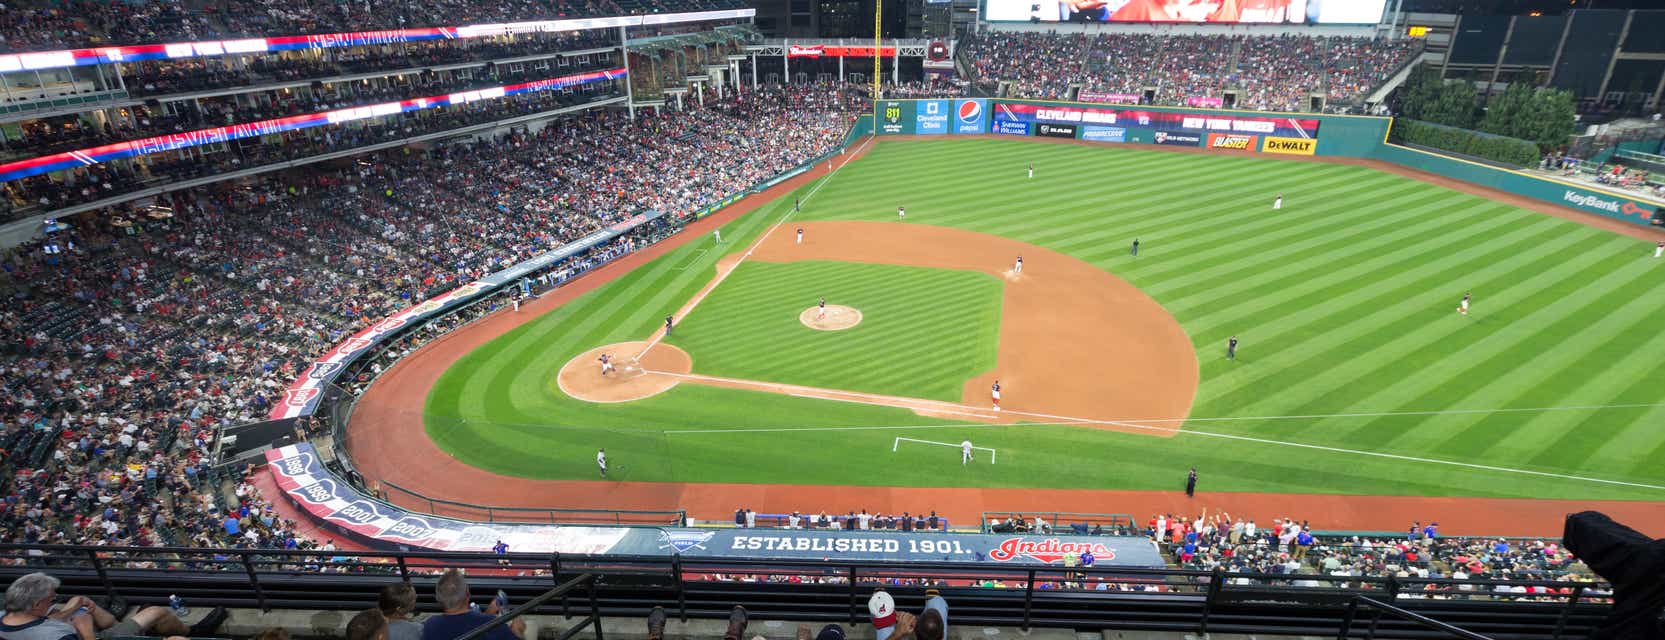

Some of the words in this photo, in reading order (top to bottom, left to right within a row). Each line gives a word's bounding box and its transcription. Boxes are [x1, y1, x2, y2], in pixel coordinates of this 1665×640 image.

[886, 106, 900, 119] 811
[1036, 109, 1082, 122] CLEVELAND
[959, 124, 979, 132] pepsi
[1563, 190, 1620, 213] KeyBank
[341, 505, 377, 524] 2001
[731, 536, 900, 553] ESTABLISHED
[908, 539, 972, 554] 1901.
[989, 537, 1116, 562] Indians
